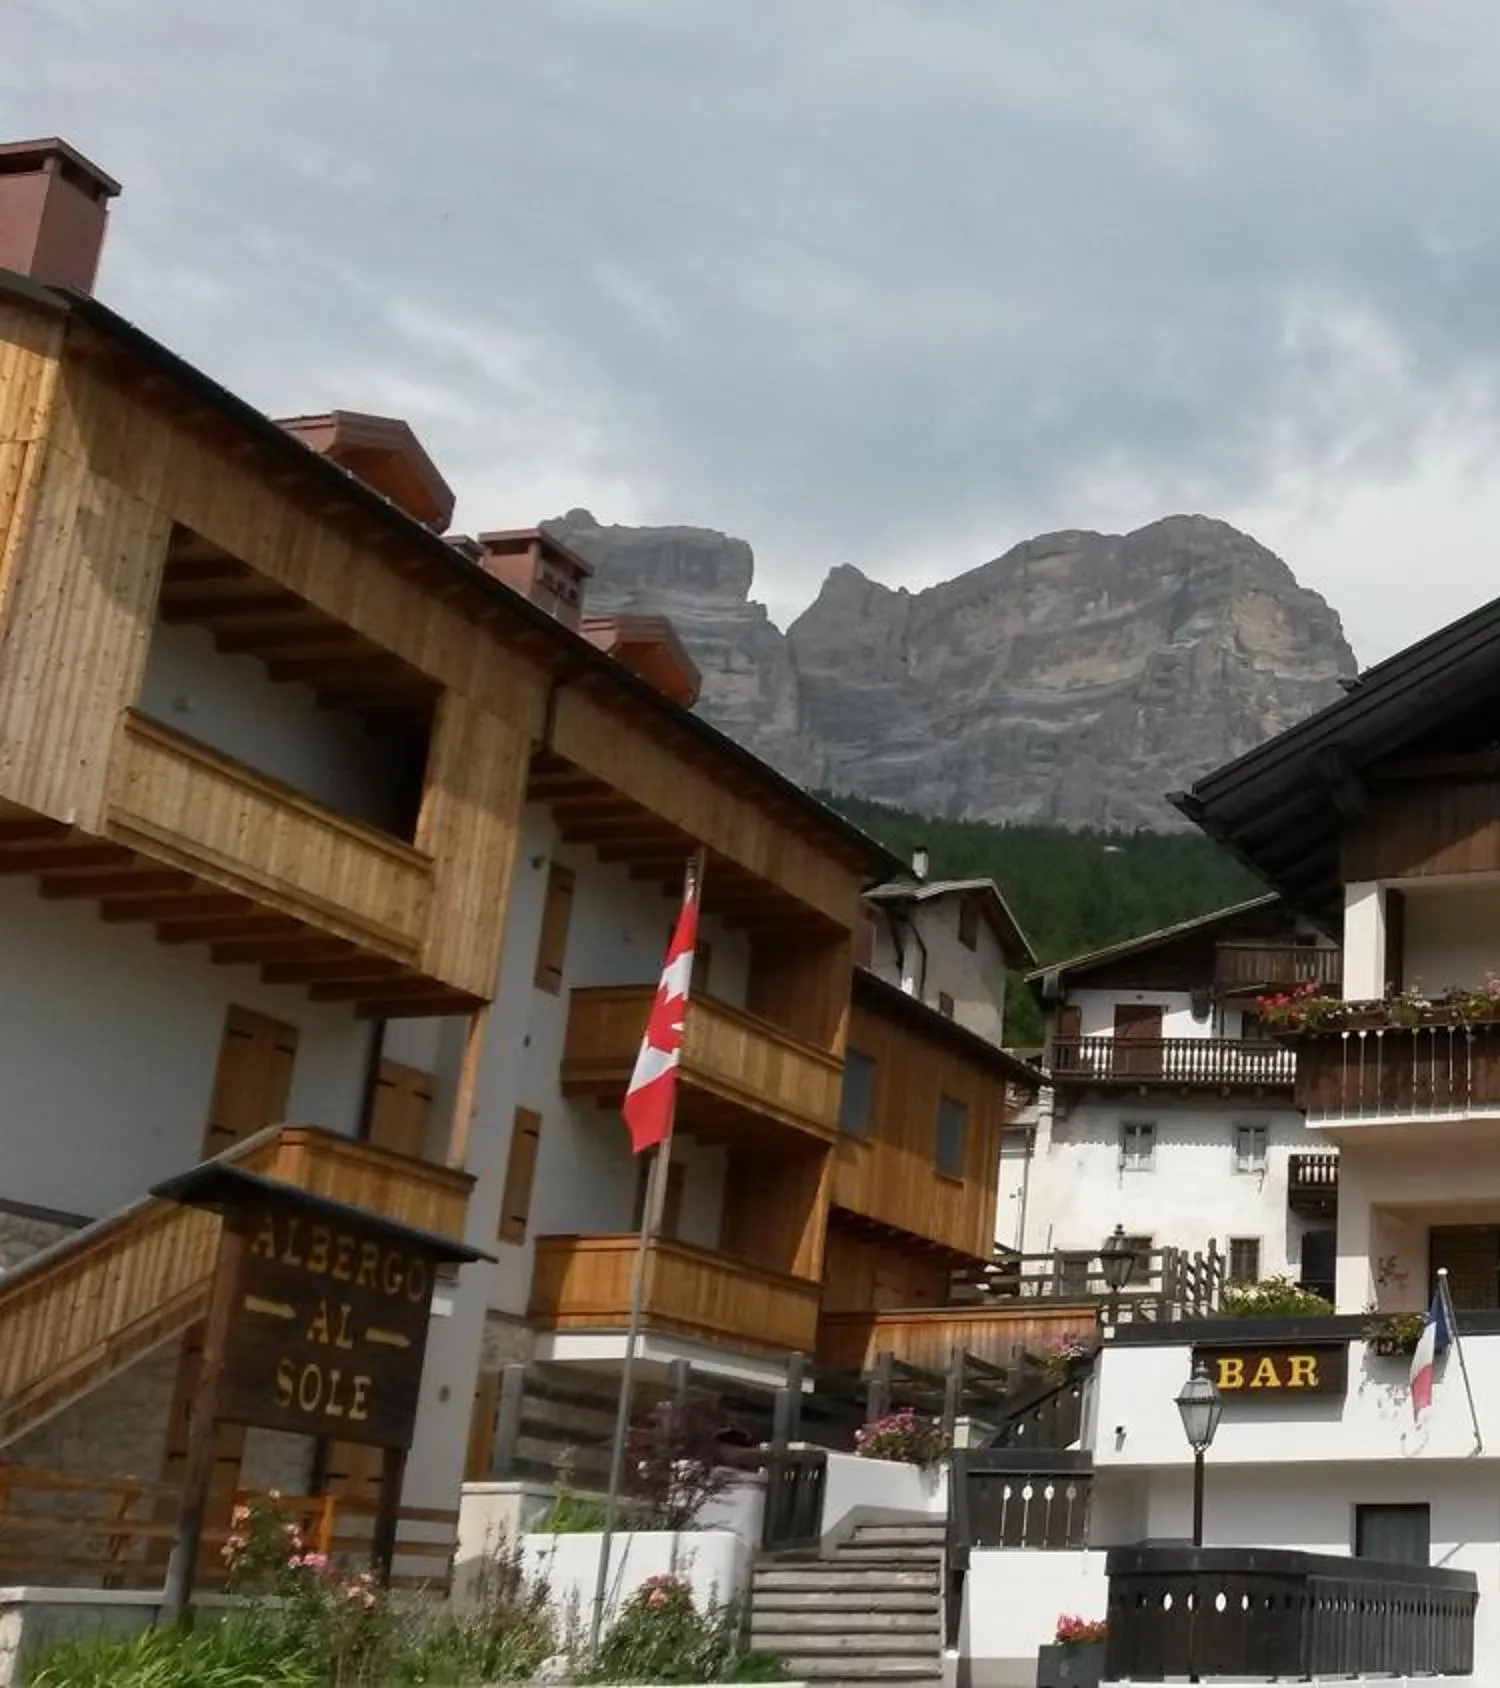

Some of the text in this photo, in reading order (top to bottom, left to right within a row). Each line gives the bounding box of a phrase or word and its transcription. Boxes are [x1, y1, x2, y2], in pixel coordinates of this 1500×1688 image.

[251, 1214, 428, 1301] ALBERGO
[306, 1300, 353, 1349] AL
[275, 1358, 372, 1420] SOLE
[1216, 1355, 1319, 1389] BAR
